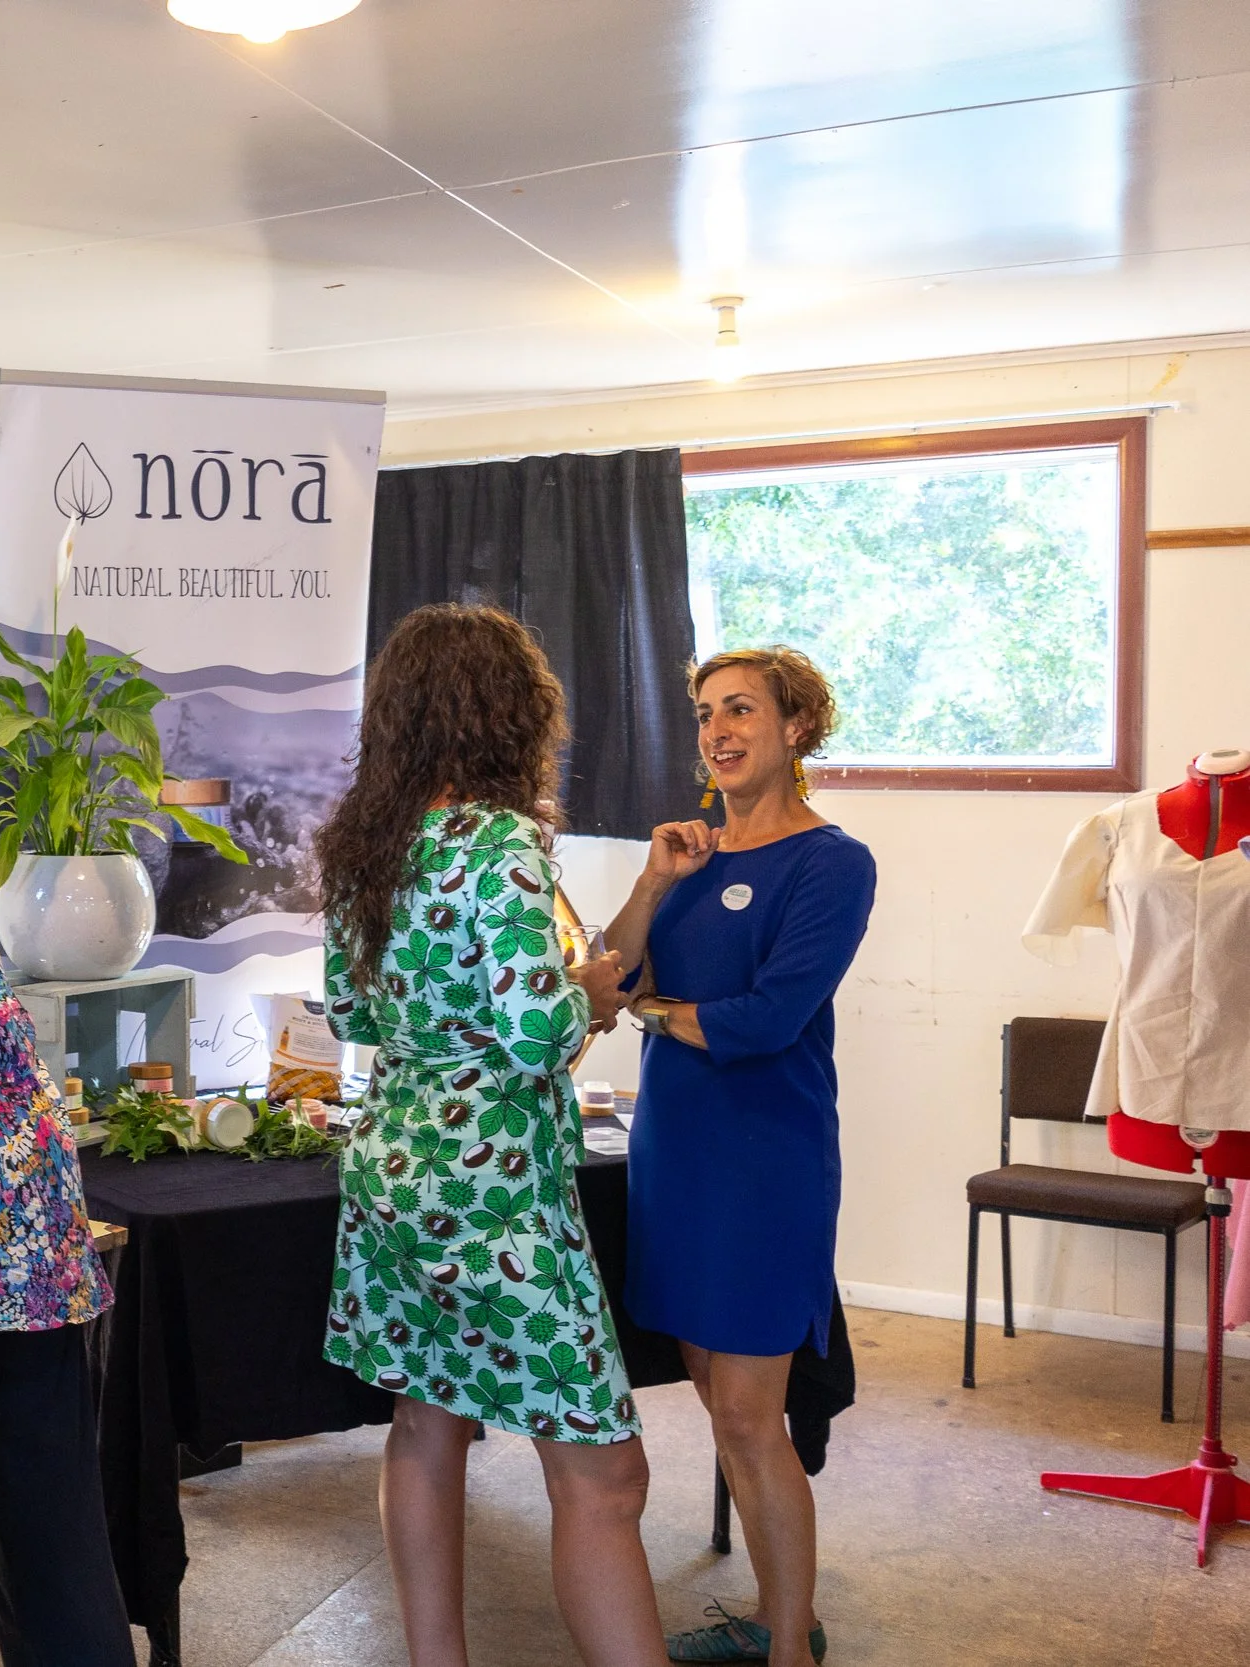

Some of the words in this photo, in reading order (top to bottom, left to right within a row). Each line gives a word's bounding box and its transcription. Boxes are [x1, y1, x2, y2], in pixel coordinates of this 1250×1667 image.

[133, 449, 332, 524] nōrā
[73, 566, 172, 597] NATURAL.
[179, 568, 283, 598] BEAUTIFUL.
[290, 569, 331, 599] YOU.
